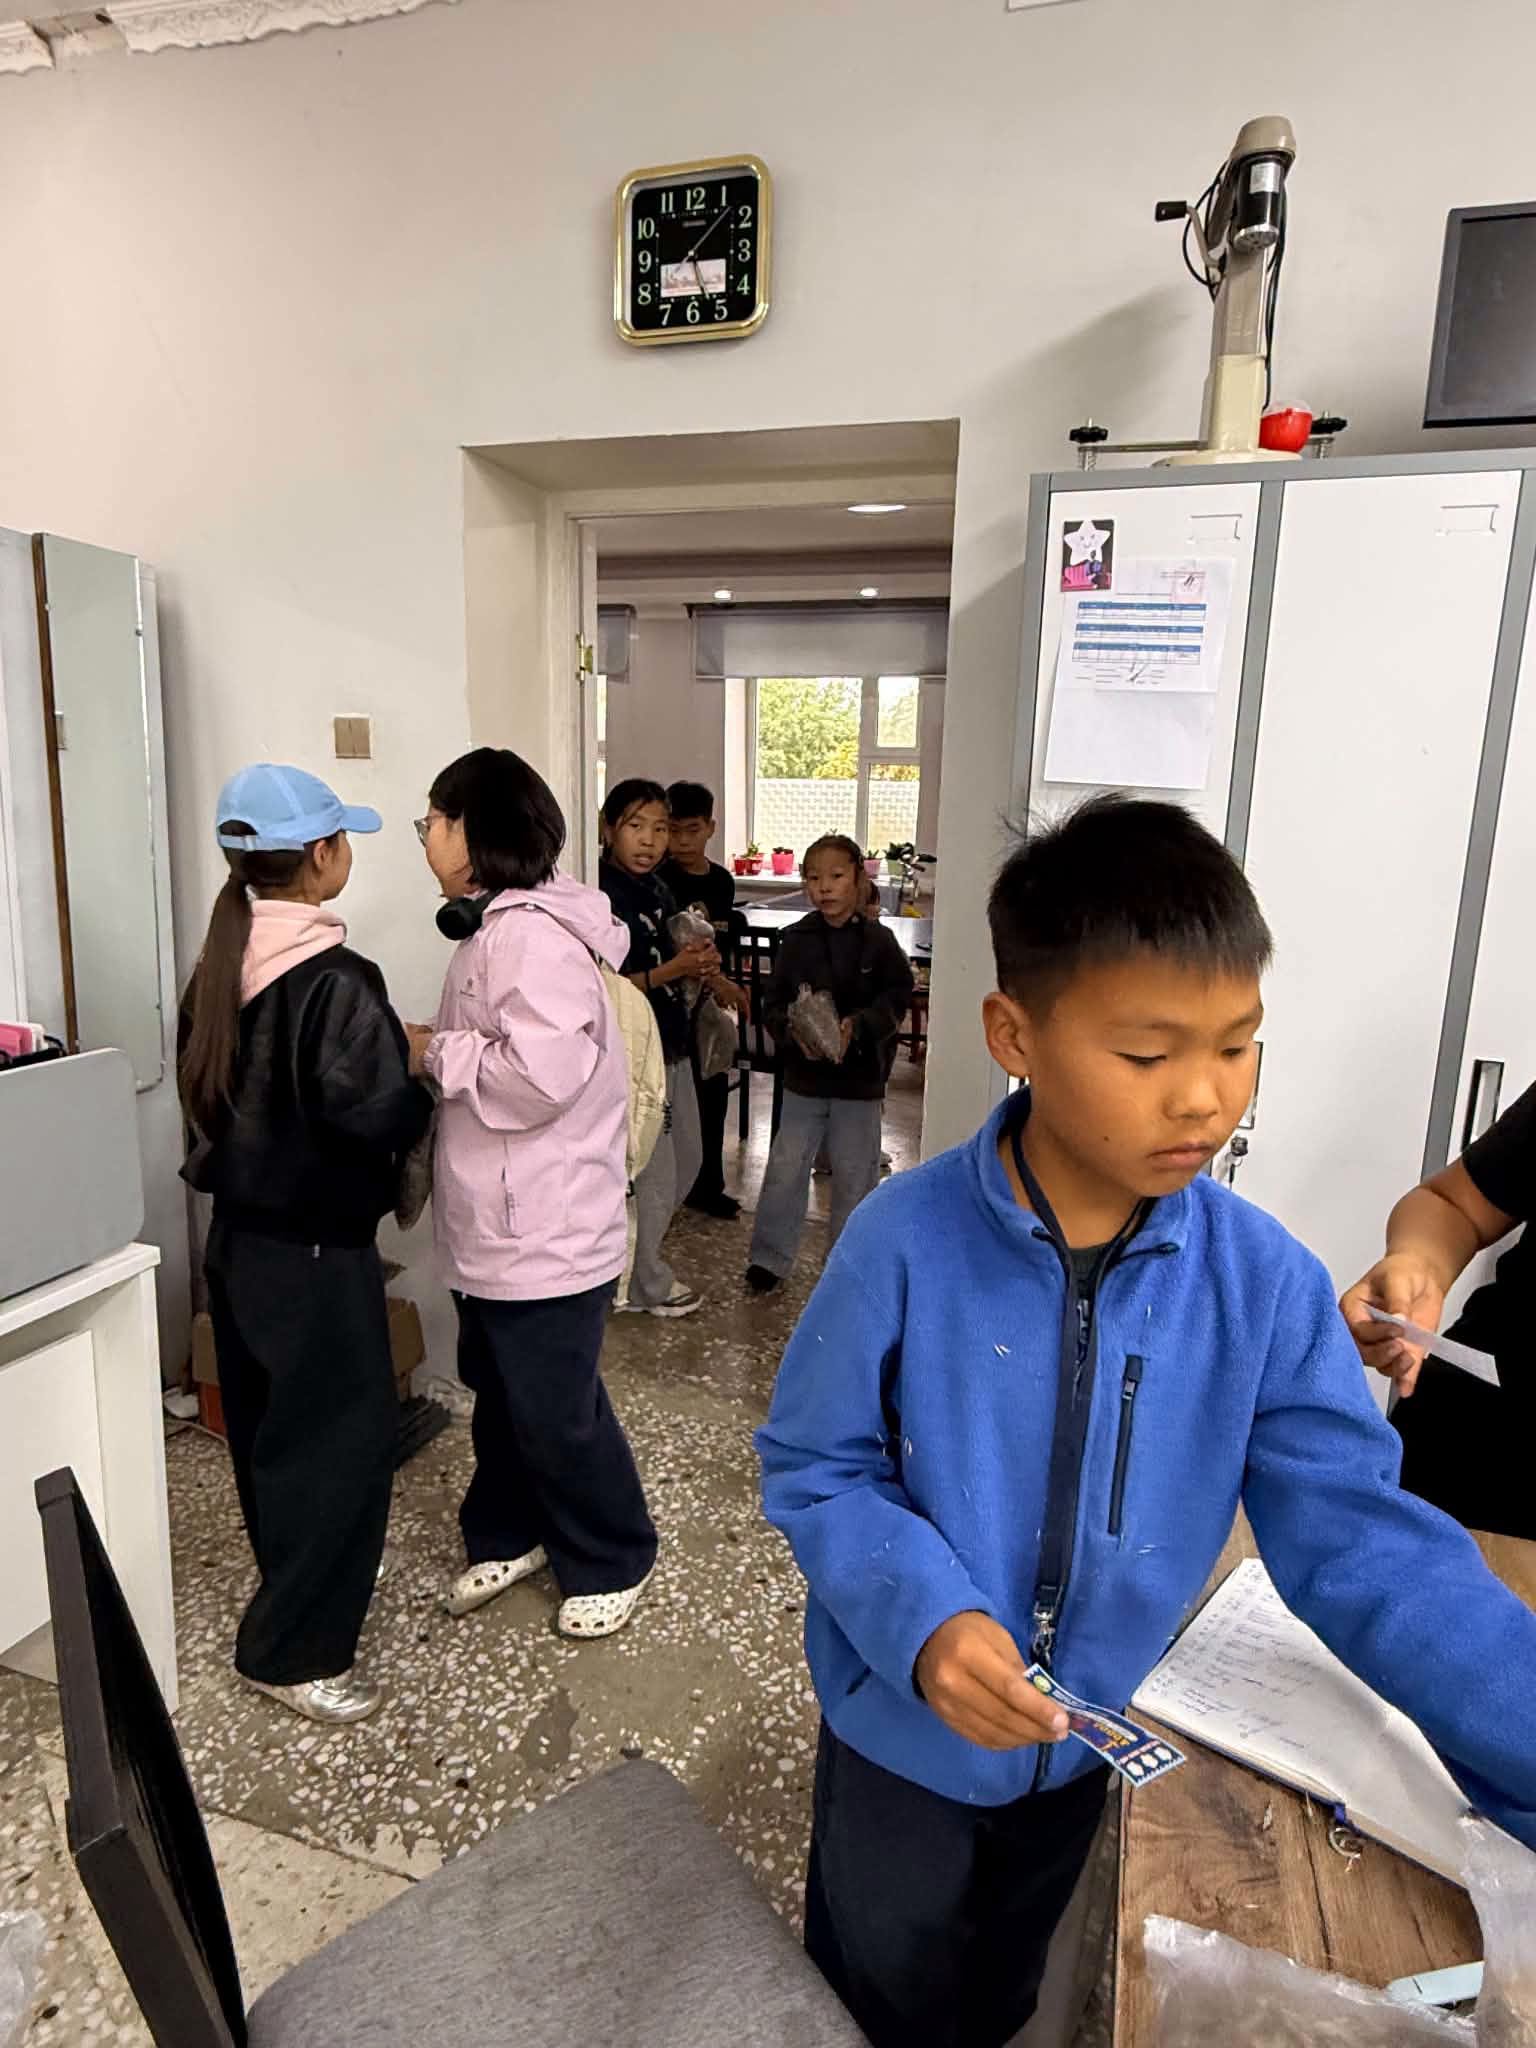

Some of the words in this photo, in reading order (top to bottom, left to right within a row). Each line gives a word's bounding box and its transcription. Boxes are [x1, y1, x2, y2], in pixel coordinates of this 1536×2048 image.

[661, 191, 673, 214] 11
[685, 187, 706, 211] 12
[721, 184, 727, 207] 1
[637, 217, 655, 240] 10
[738, 205, 752, 229] 2
[638, 250, 652, 274] 9
[738, 238, 751, 263] 3
[637, 283, 652, 305] 8
[736, 273, 750, 296] 4
[659, 303, 672, 326] 7
[686, 301, 700, 324] 6
[714, 299, 728, 321] 5
